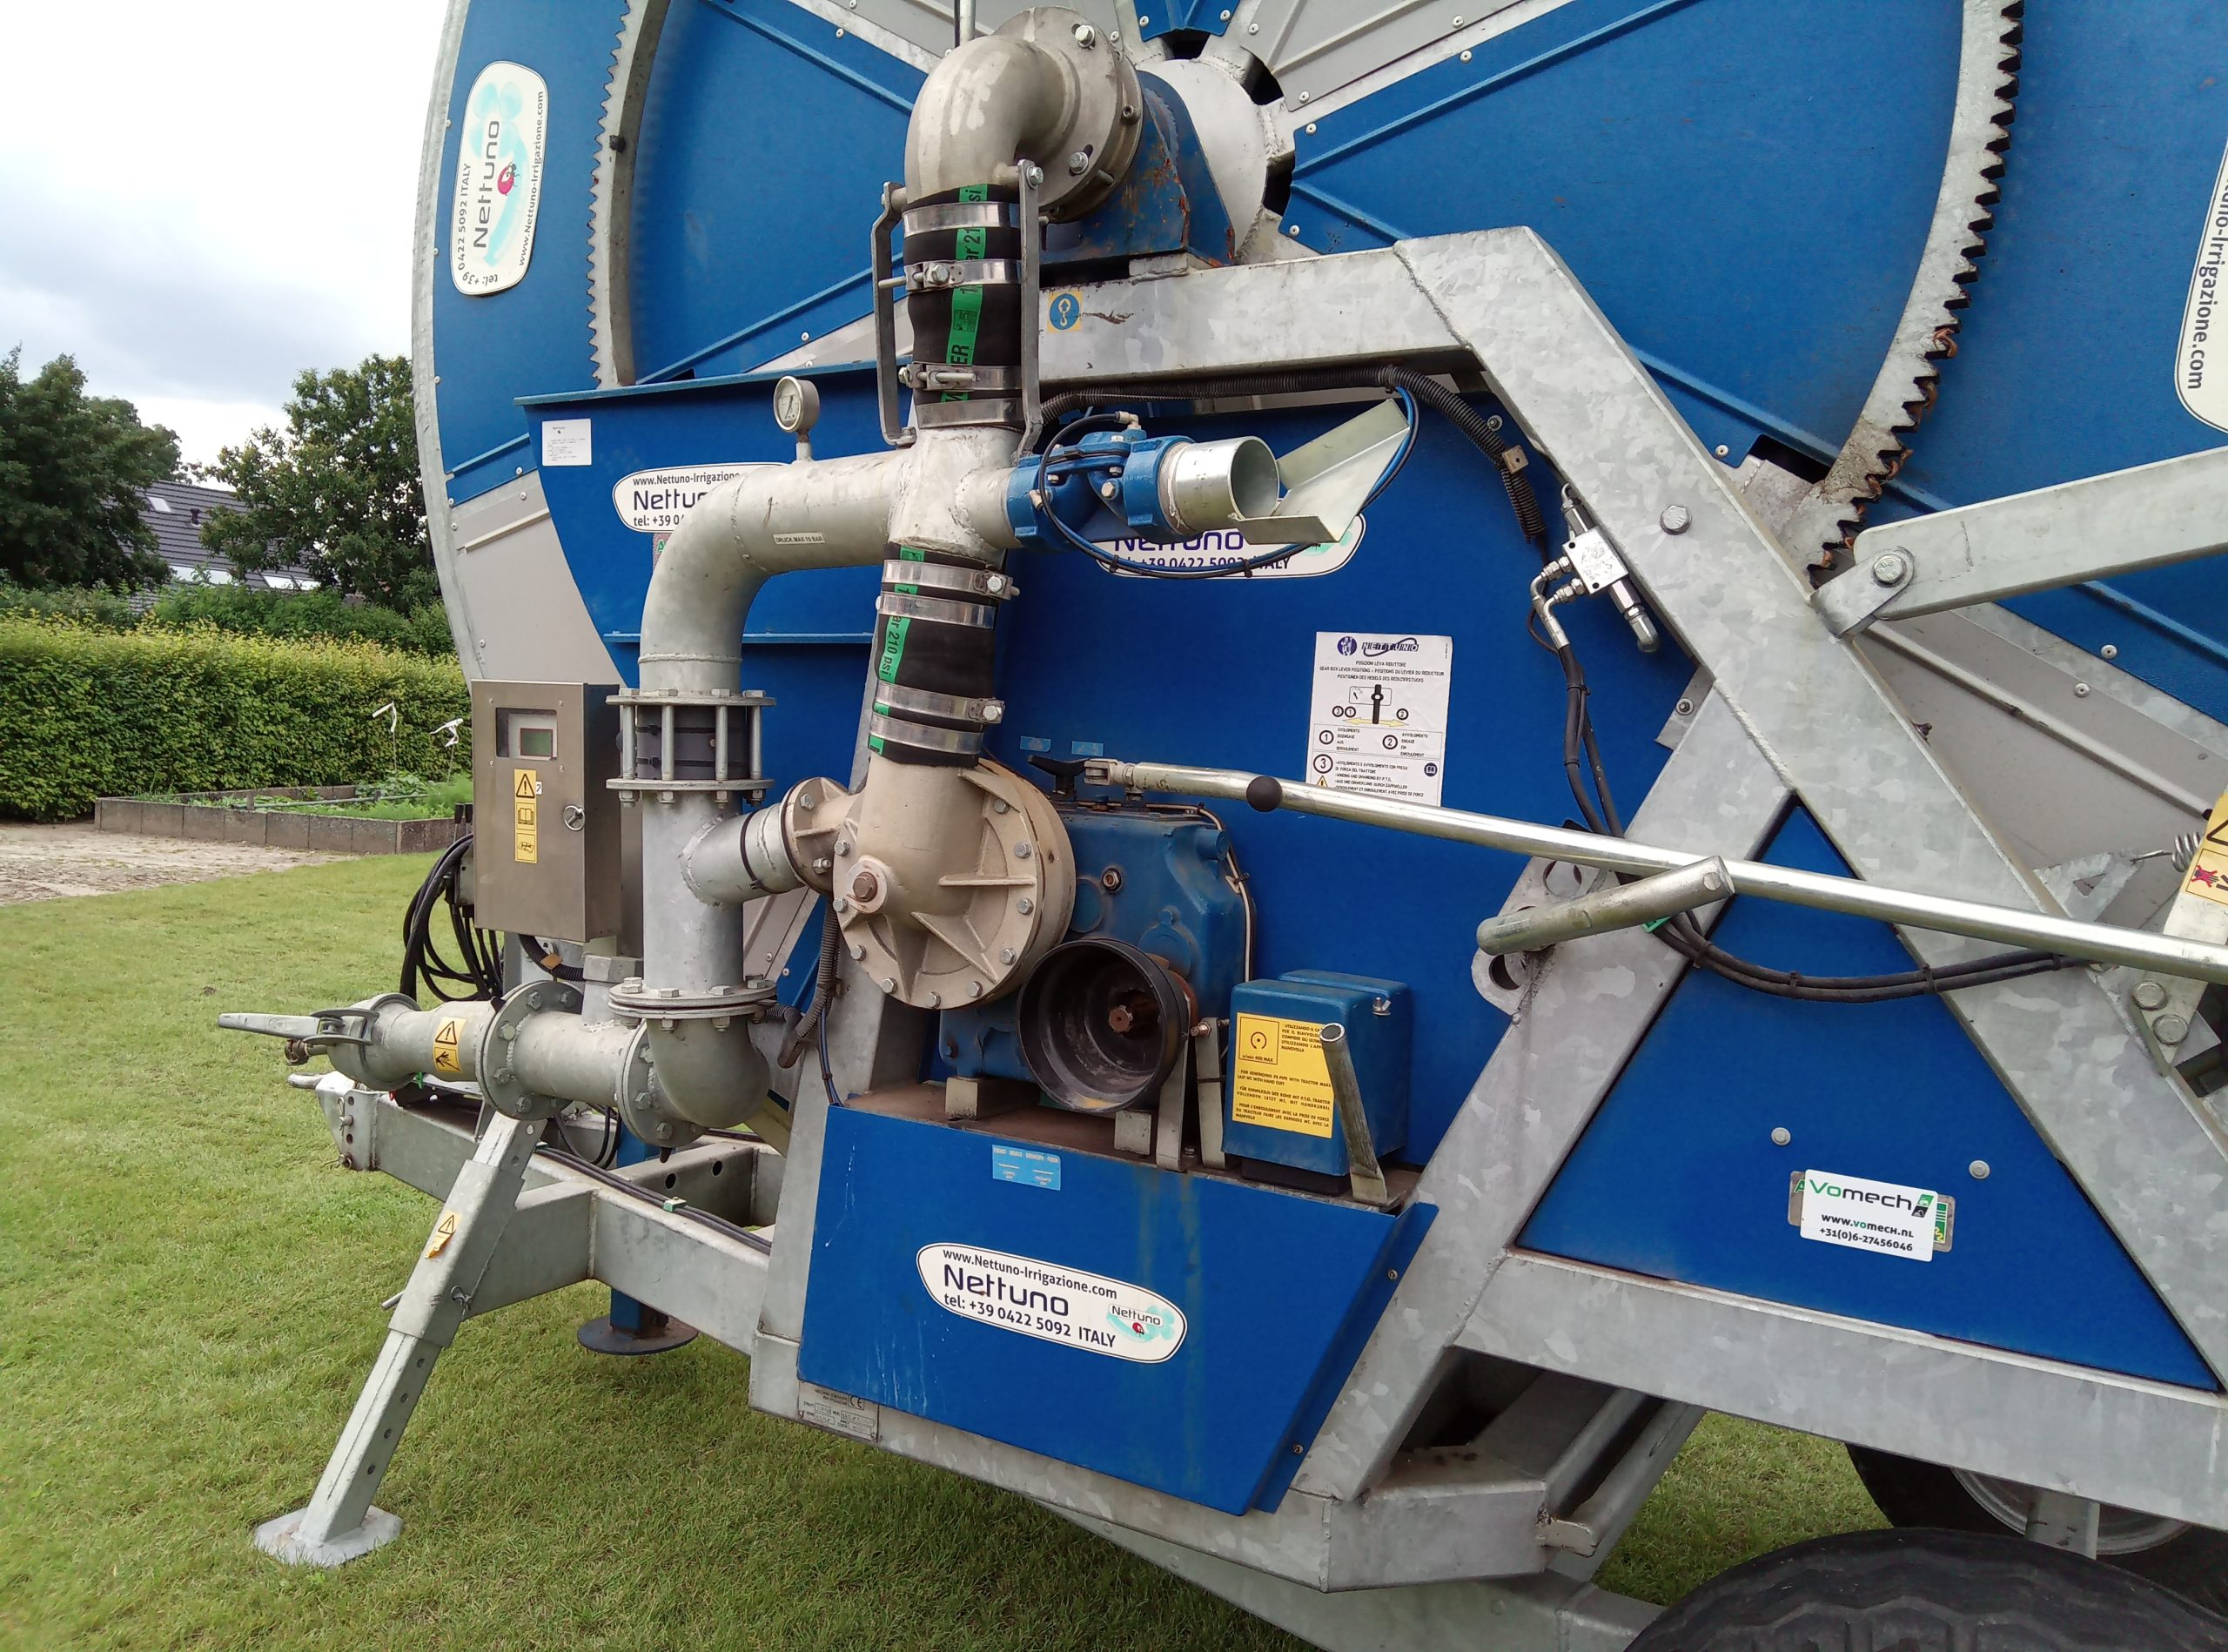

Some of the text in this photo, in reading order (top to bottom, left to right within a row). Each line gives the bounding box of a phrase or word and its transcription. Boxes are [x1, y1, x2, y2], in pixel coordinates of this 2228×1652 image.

[460, 163, 472, 196] ITALY
[473, 120, 500, 248] Nettuno
[519, 91, 544, 266] www.Nettuno-Irrigazione.com
[965, 189, 982, 202] si
[458, 201, 467, 232] 5092
[457, 236, 466, 271] 0422
[462, 272, 480, 285] +39
[634, 514, 650, 527] tel:
[652, 514, 671, 527] +39
[887, 630, 900, 655] 210
[1361, 641, 1419, 652] NETTUNO
[881, 655, 893, 676] psi
[1320, 757, 1326, 769] 3
[1809, 1179, 1912, 1211] Vomech
[1820, 1228, 1913, 1252] +31(0)6-27456046
[943, 1249, 1117, 1299] www.Nettuno-Irrigazione.com
[943, 1264, 1069, 1317] Nettuno
[944, 1293, 1116, 1347] tel: +39 0422 5092 ITALY
[1111, 1305, 1161, 1326] Nettuno
